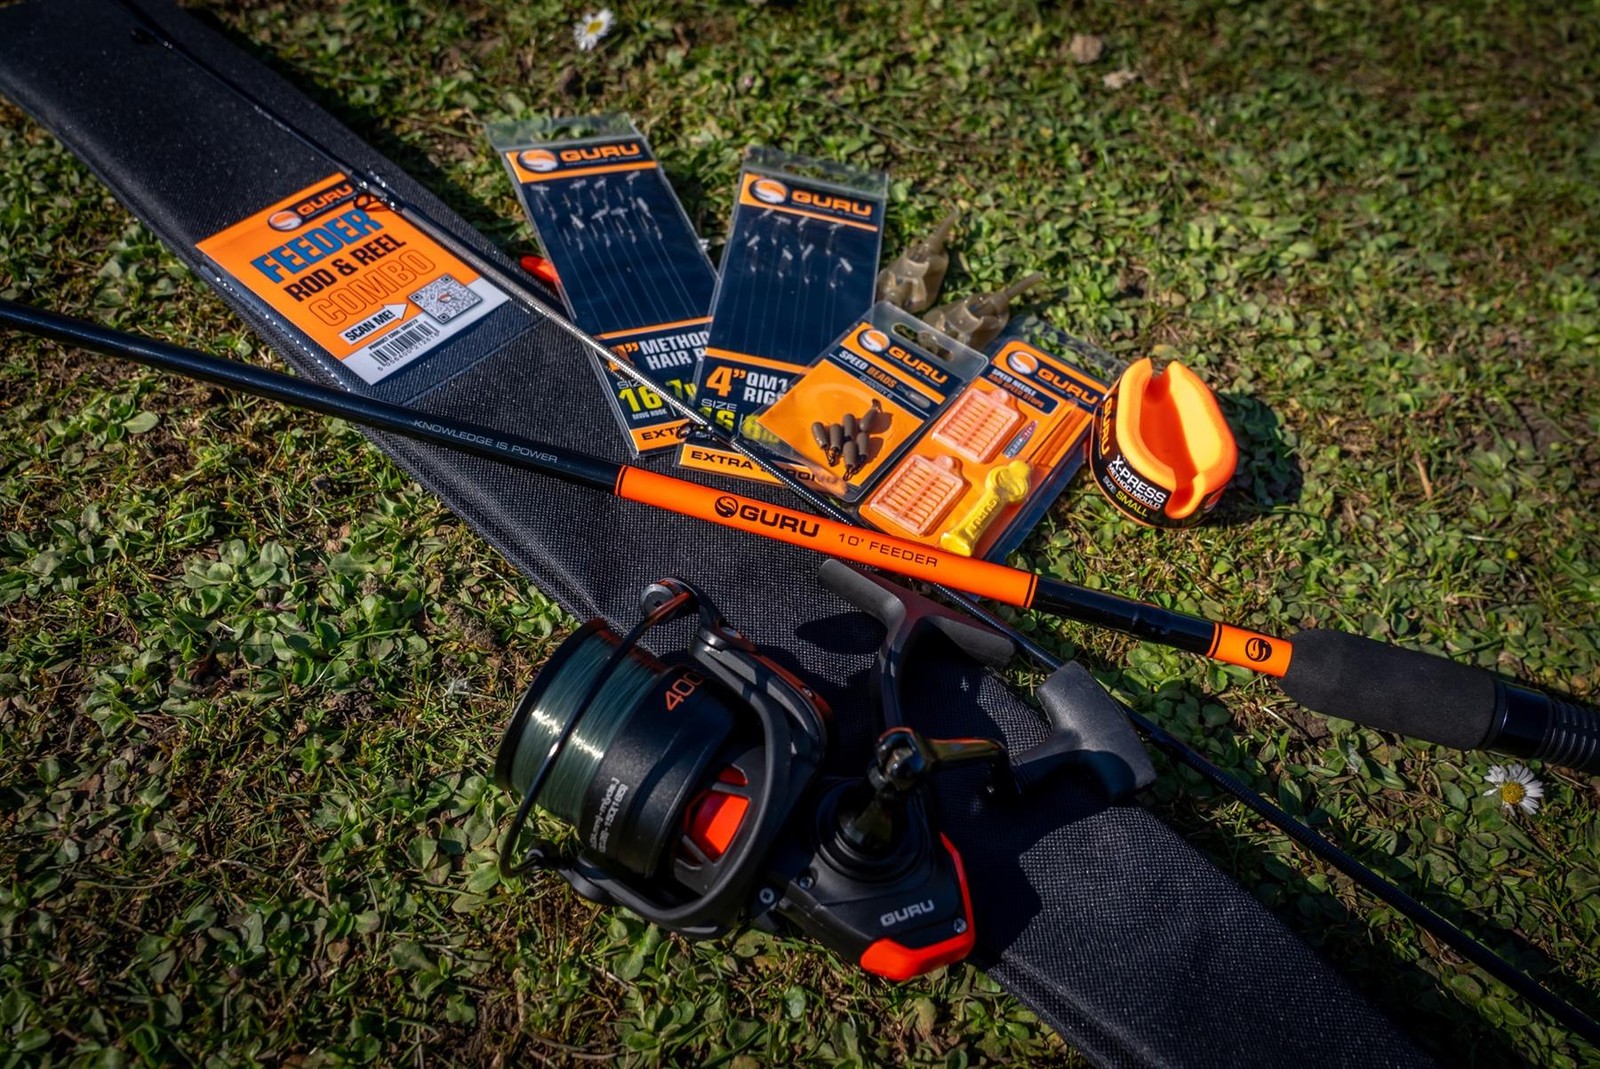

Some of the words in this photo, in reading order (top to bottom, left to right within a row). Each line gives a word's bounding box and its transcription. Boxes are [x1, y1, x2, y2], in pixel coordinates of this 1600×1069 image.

[560, 143, 640, 162] GURU
[296, 184, 354, 216] GURU
[791, 190, 873, 216] GURU
[250, 208, 384, 284] FEEDER
[283, 269, 337, 302] ROD
[331, 258, 359, 276] &
[349, 234, 407, 266] REEL
[309, 250, 436, 326] COMBO
[345, 321, 376, 341] SCAN
[372, 310, 396, 325] ME!
[646, 350, 693, 370] HAIR
[839, 350, 869, 370] SPEED
[866, 366, 897, 388] BEADS
[888, 346, 948, 384] GURU
[618, 385, 663, 412] 16
[746, 372, 788, 392] QM1
[1037, 368, 1099, 404] GURU
[701, 398, 738, 412] SIZE
[412, 420, 493, 446] KNOWLEDGE
[496, 441, 508, 450] IS
[511, 445, 558, 463] POWER
[1102, 397, 1113, 455] GURU
[691, 450, 753, 470] EXTRA
[1108, 462, 1132, 492] METHOD
[1132, 487, 1161, 510] MOULD
[1112, 454, 1166, 504] X-PRESS
[1116, 490, 1148, 516] SMALL
[739, 504, 820, 537] GURU
[839, 533, 865, 546] 10'
[869, 541, 938, 567] FEEDER
[880, 899, 935, 927] GURU
